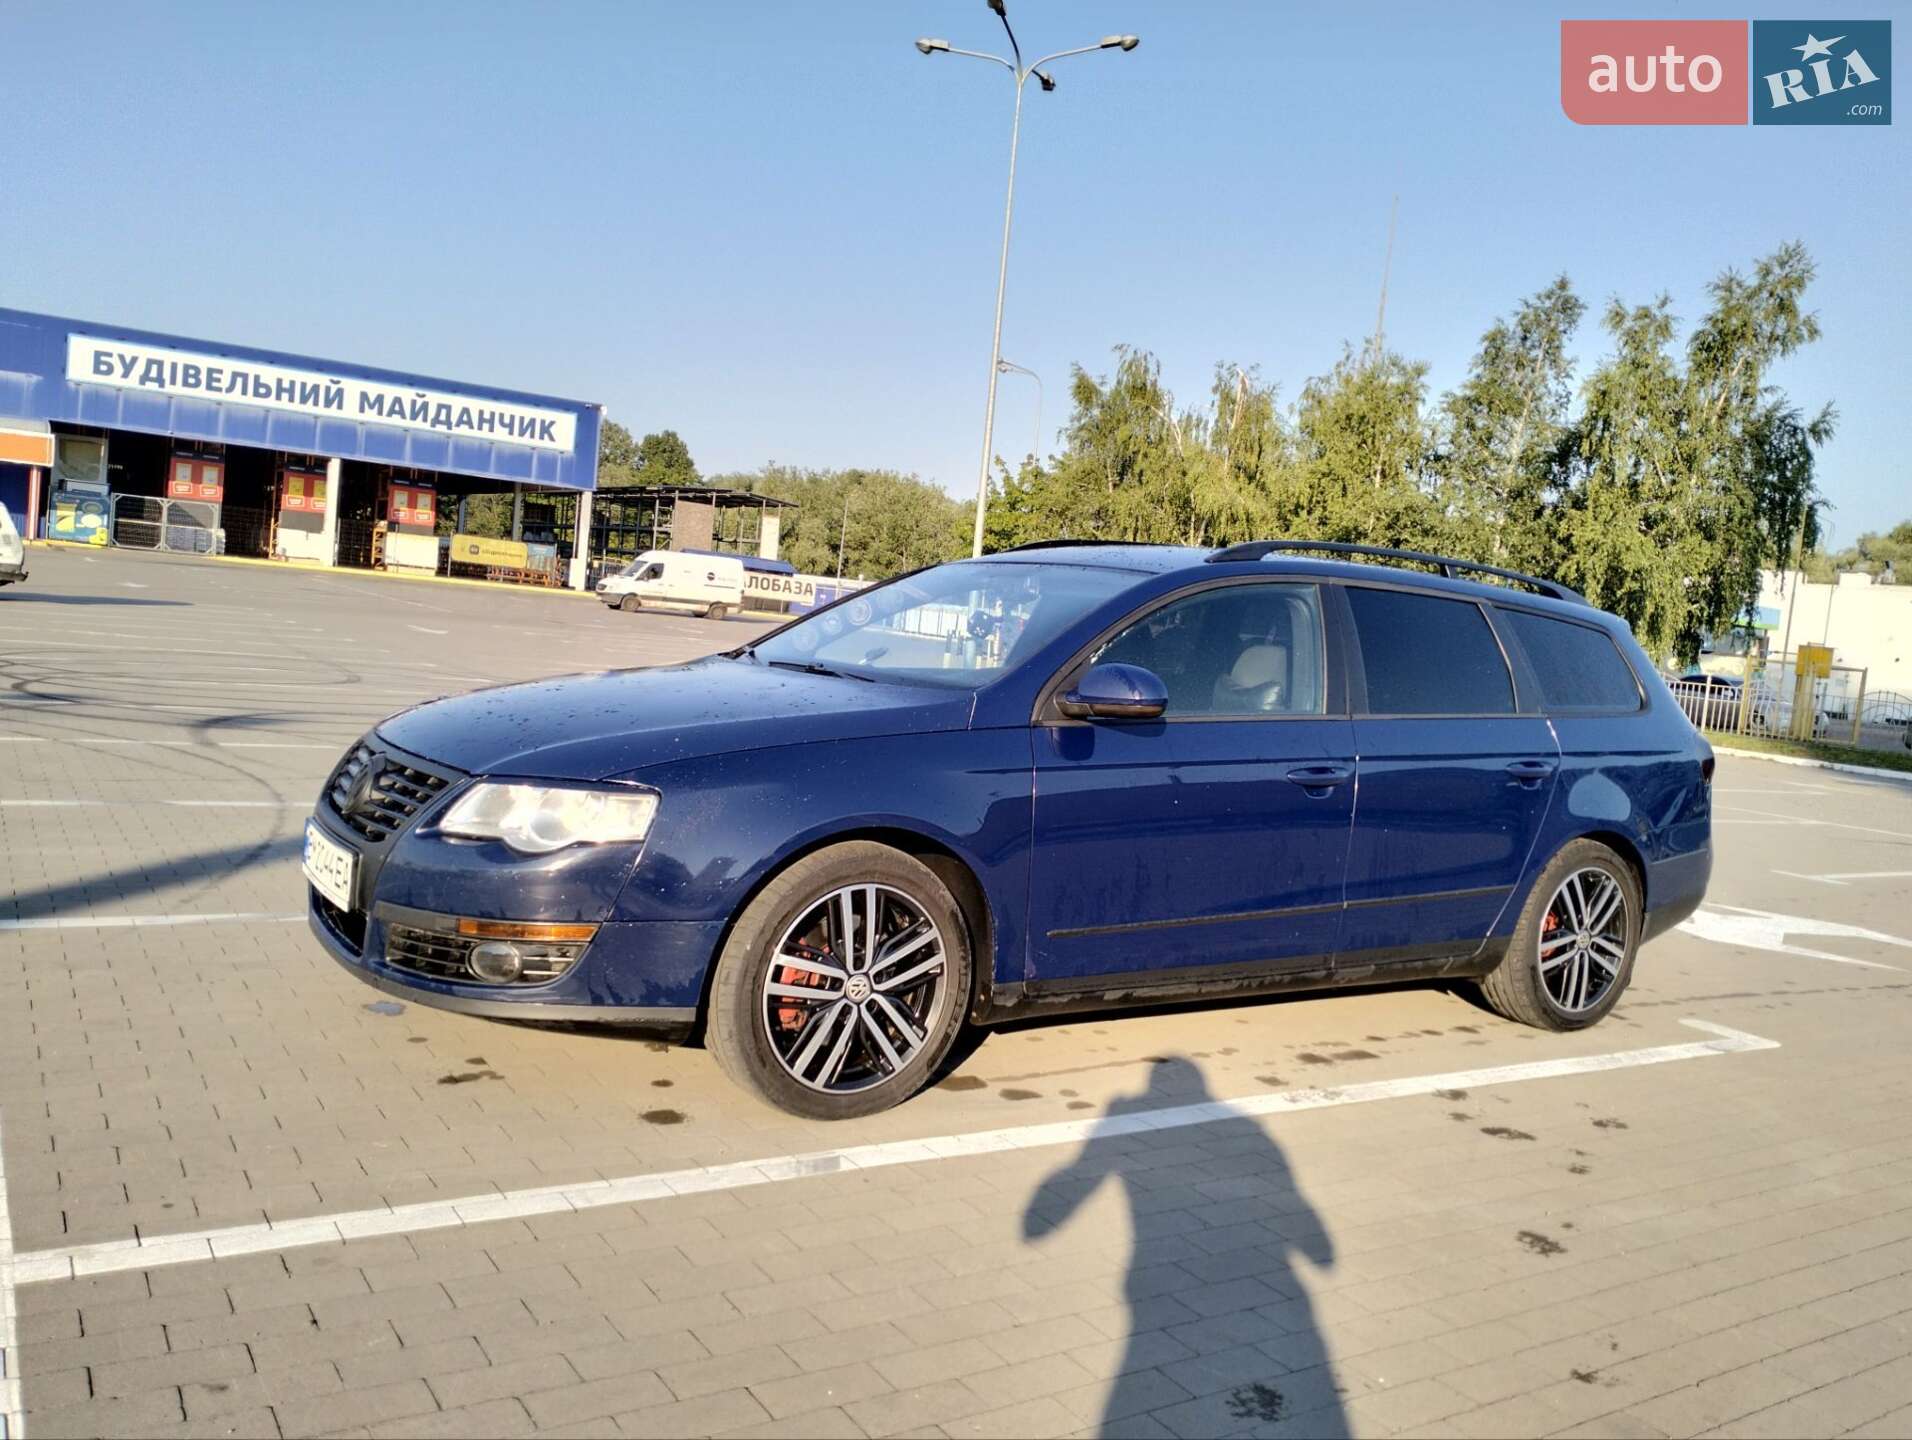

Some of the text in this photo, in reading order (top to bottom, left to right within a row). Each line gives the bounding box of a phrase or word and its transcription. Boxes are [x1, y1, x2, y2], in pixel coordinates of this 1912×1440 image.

[92, 349, 557, 443] БУДІВЕЛЬНИЙ МАЙДАНЧИК
[742, 575, 814, 597] ЛОБАЗА
